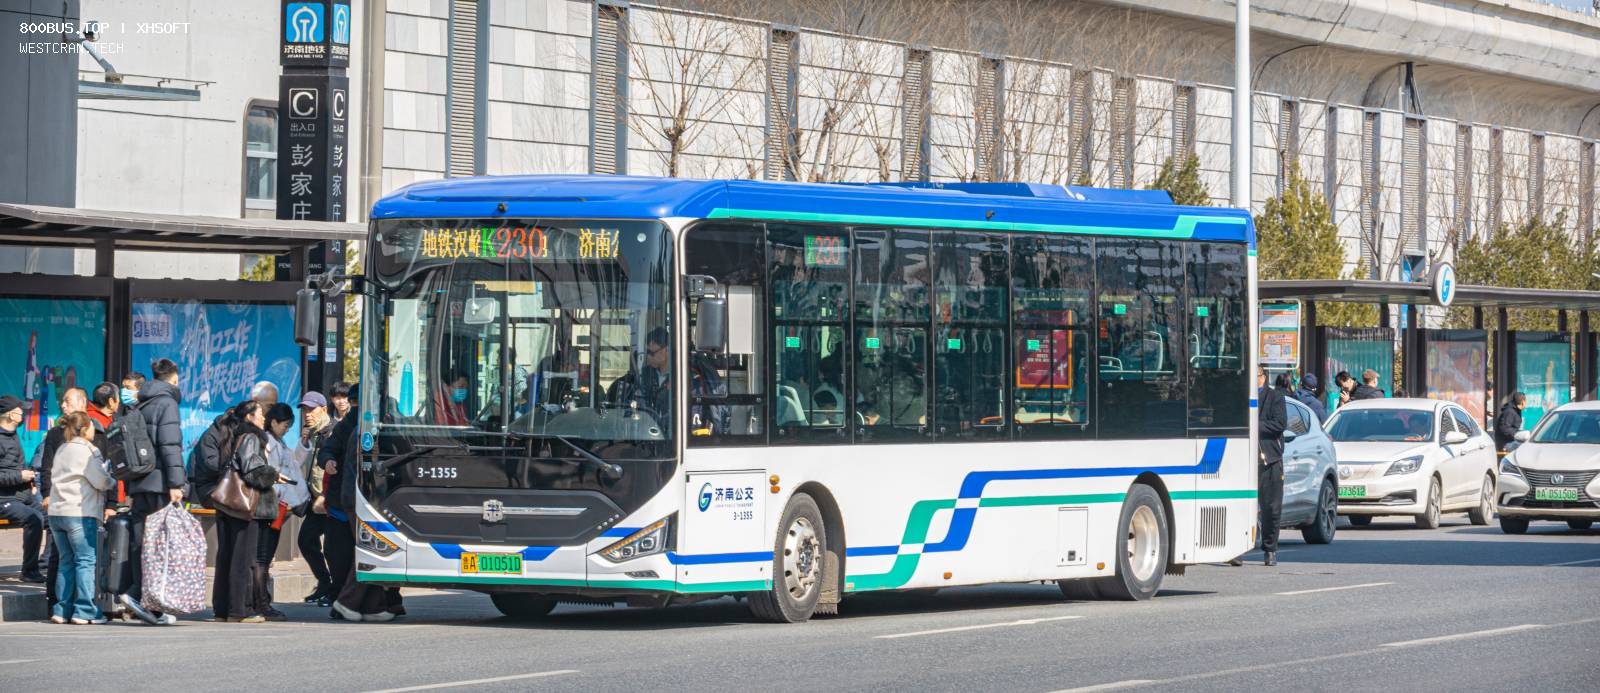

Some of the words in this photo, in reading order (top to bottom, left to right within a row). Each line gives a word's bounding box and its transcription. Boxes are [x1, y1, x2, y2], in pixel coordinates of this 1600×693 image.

[284, 45, 326, 54] 济南地铁
[292, 91, 314, 116] C
[334, 92, 344, 117] C
[290, 122, 315, 132] 出入口
[481, 227, 544, 258] K230
[417, 467, 457, 479] 3-1355
[715, 486, 754, 501] 济南公交
[733, 511, 753, 521] 3-1355
